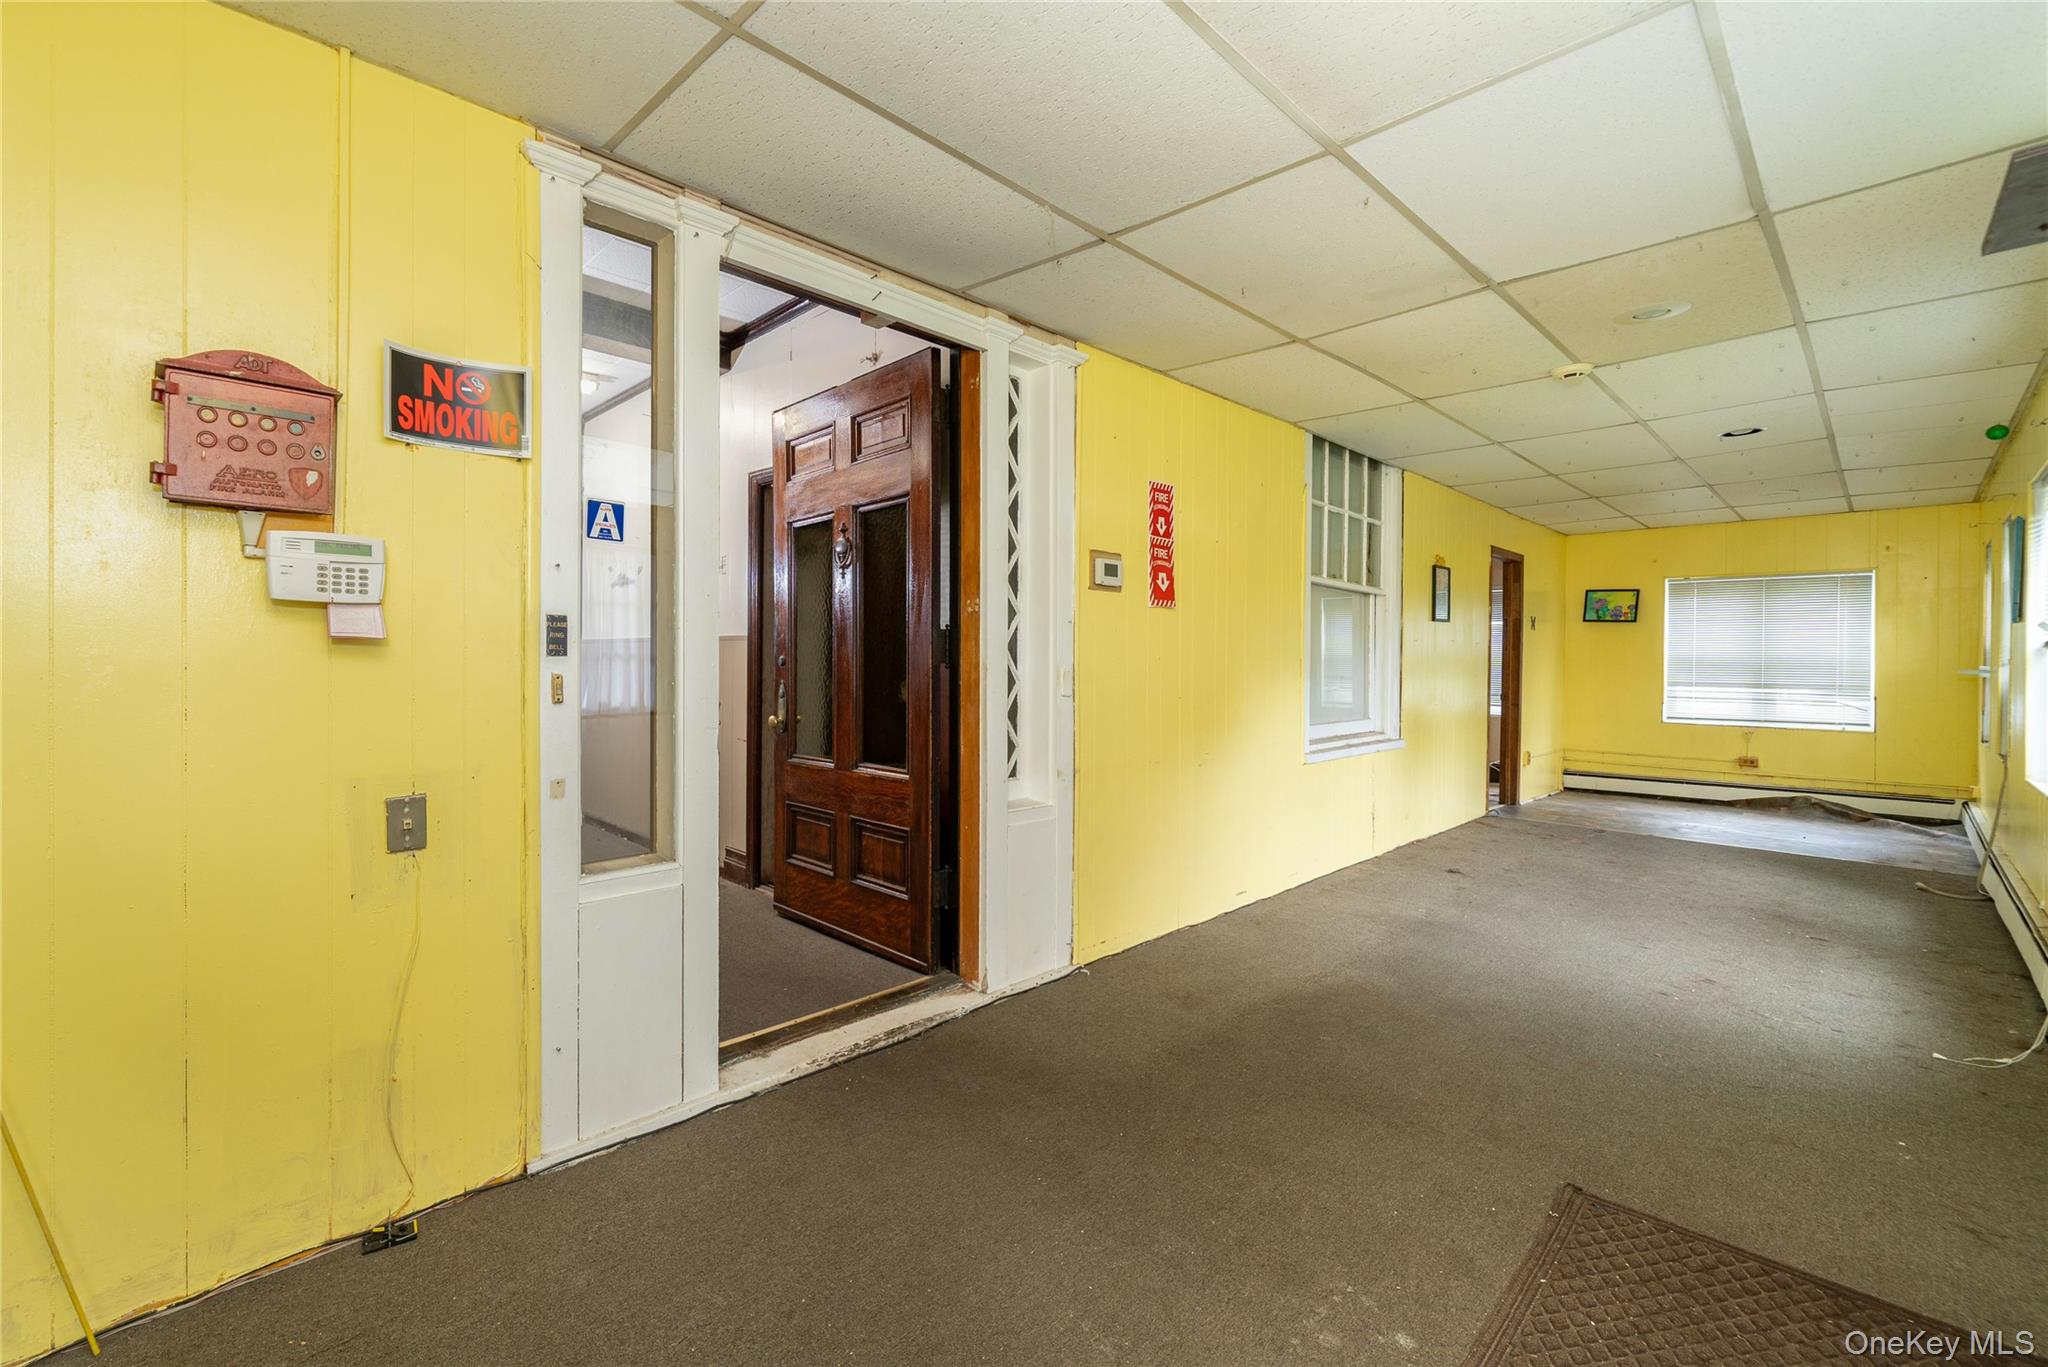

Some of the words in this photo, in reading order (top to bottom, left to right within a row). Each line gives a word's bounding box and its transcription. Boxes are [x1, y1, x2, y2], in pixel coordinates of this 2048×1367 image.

[234, 355, 273, 374] ADT
[398, 394, 518, 446] SMOKING
[1154, 491, 1169, 504] FIRE
[1153, 547, 1169, 559] FIRE
